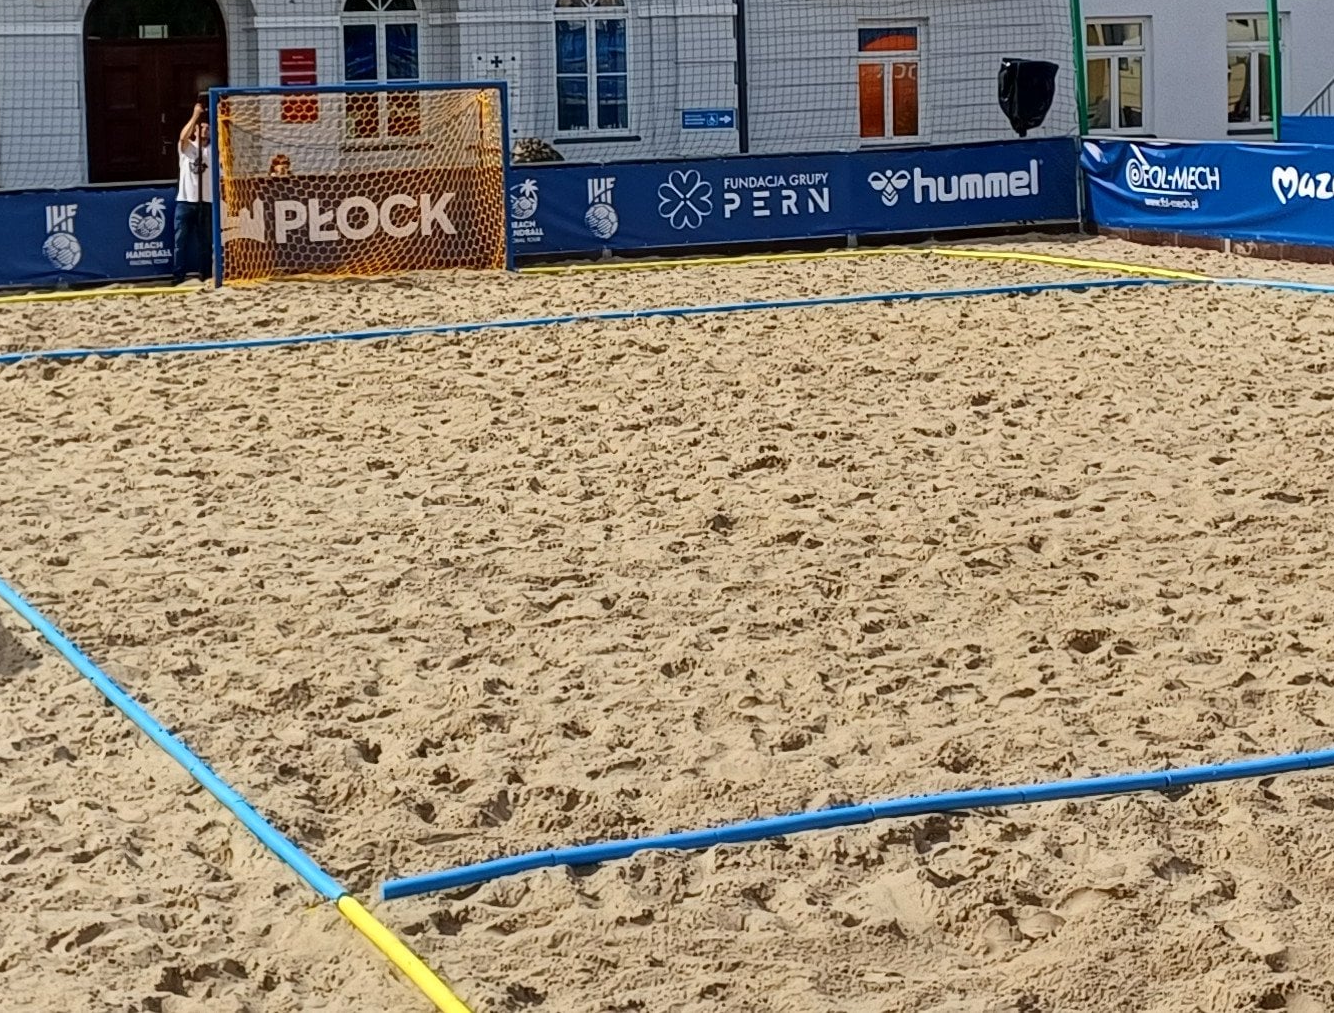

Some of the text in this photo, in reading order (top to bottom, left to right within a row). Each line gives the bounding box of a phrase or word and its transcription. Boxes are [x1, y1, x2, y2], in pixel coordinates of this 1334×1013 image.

[587, 177, 616, 205] IHF
[724, 172, 829, 190] FUNDACJA GRUPY
[913, 158, 1040, 204] hummel
[274, 192, 458, 244] PŁOCK
[723, 188, 830, 218] PERN
[45, 203, 78, 235] IHF
